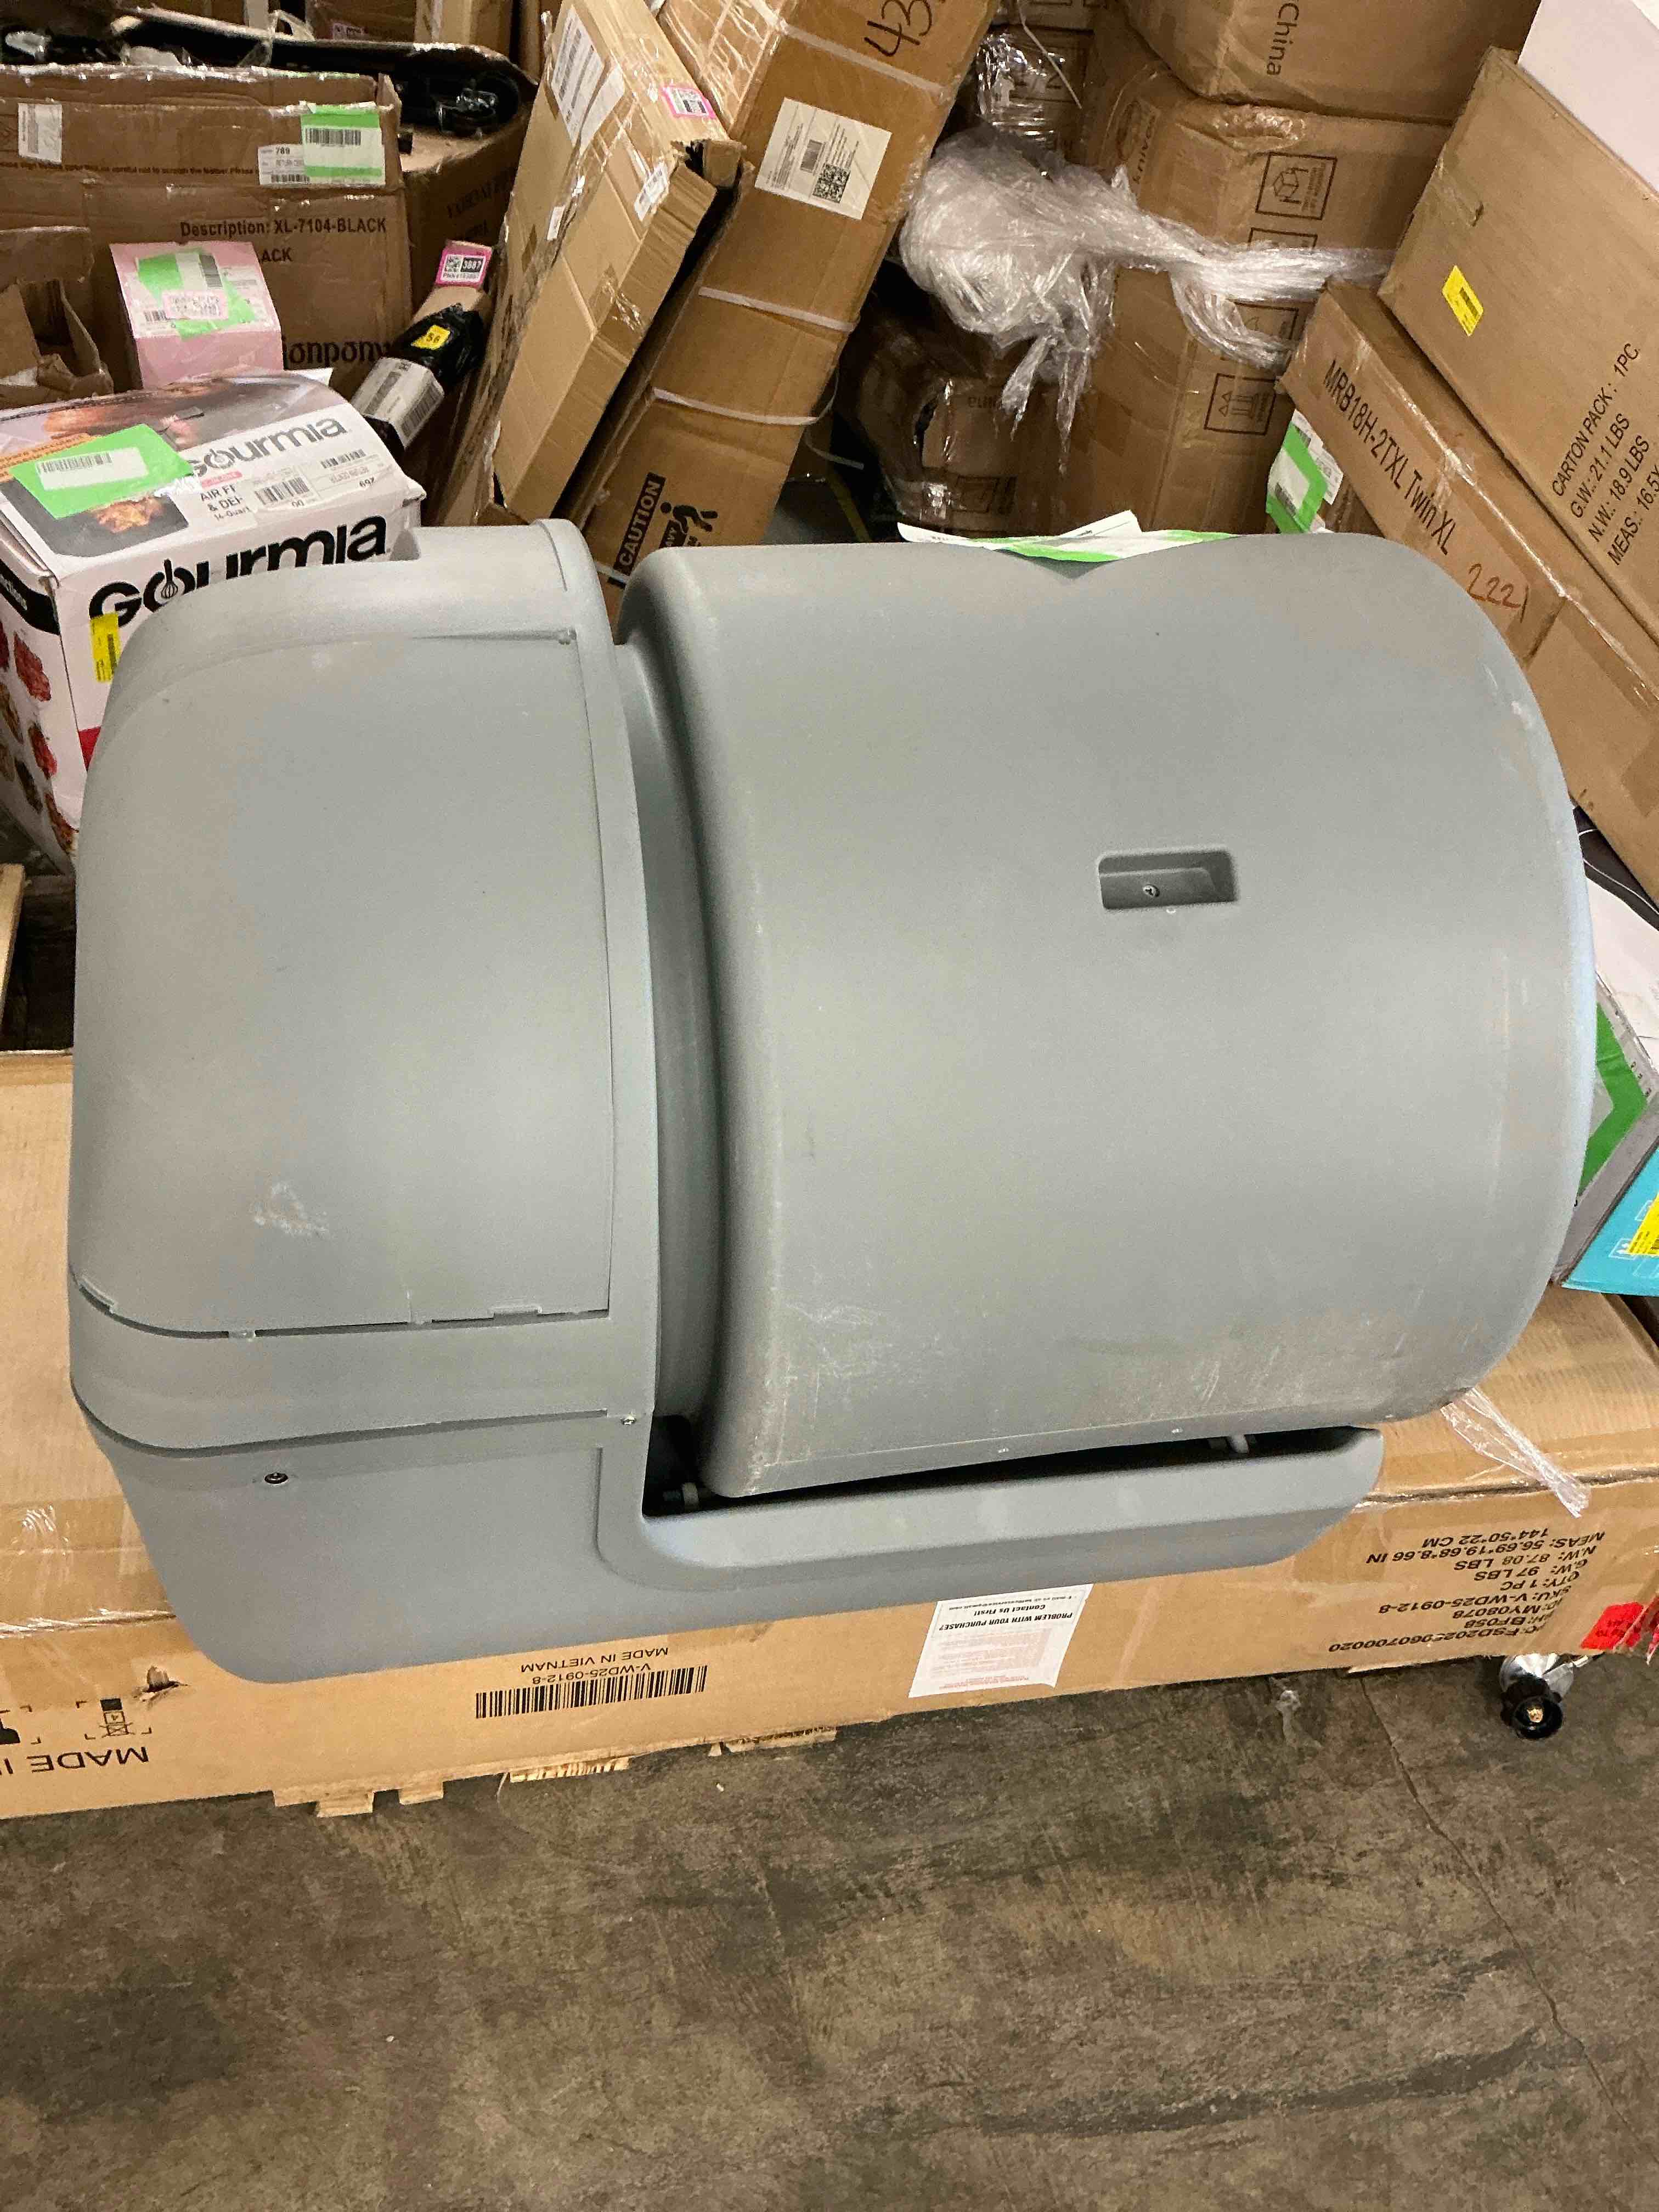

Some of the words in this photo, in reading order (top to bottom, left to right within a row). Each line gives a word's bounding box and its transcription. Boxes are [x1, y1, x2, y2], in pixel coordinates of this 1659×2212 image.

[1267, 3, 1299, 75] China
[180, 221, 270, 238] Description:
[274, 218, 386, 234] XL-7104-BLACK
[260, 248, 293, 263] ACK
[1553, 431, 1589, 496] CARTON
[1613, 343, 1639, 376] 1PC
[1590, 444, 1612, 482] 21.1
[1605, 413, 1629, 449] LBS
[1611, 467, 1632, 500] 18.9
[1624, 435, 1649, 472] LBS
[201, 488, 222, 501] AIR
[1404, 469, 1439, 529] Twin
[1431, 511, 1457, 555] XL
[619, 480, 660, 566] CAUTION
[1422, 1538, 1454, 1548] CM
[1549, 1531, 1605, 1548] MEAS:
[1366, 1553, 1387, 1564] IN
[1454, 1558, 1494, 1571] LBS
[1502, 1553, 1550, 1565] 87.08
[1474, 1568, 1511, 1581] LBS
[1516, 1566, 1539, 1577] 97
[1500, 1580, 1525, 1591] PC
[1530, 1580, 1537, 1588] 1
[1012, 1604, 1046, 1613] Contact
[1379, 1593, 1527, 1614] V-WD25-0912-8
[1034, 1612, 1073, 1622] PROBLEM
[939, 1620, 988, 1630] PURCHASE?
[601, 1654, 616, 1663] IN
[622, 1647, 668, 1660] MADE
[521, 1657, 595, 1673] VIETNAM
[532, 1663, 651, 1685] V-WD25-0912-8
[26, 1746, 149, 1773] MADE
